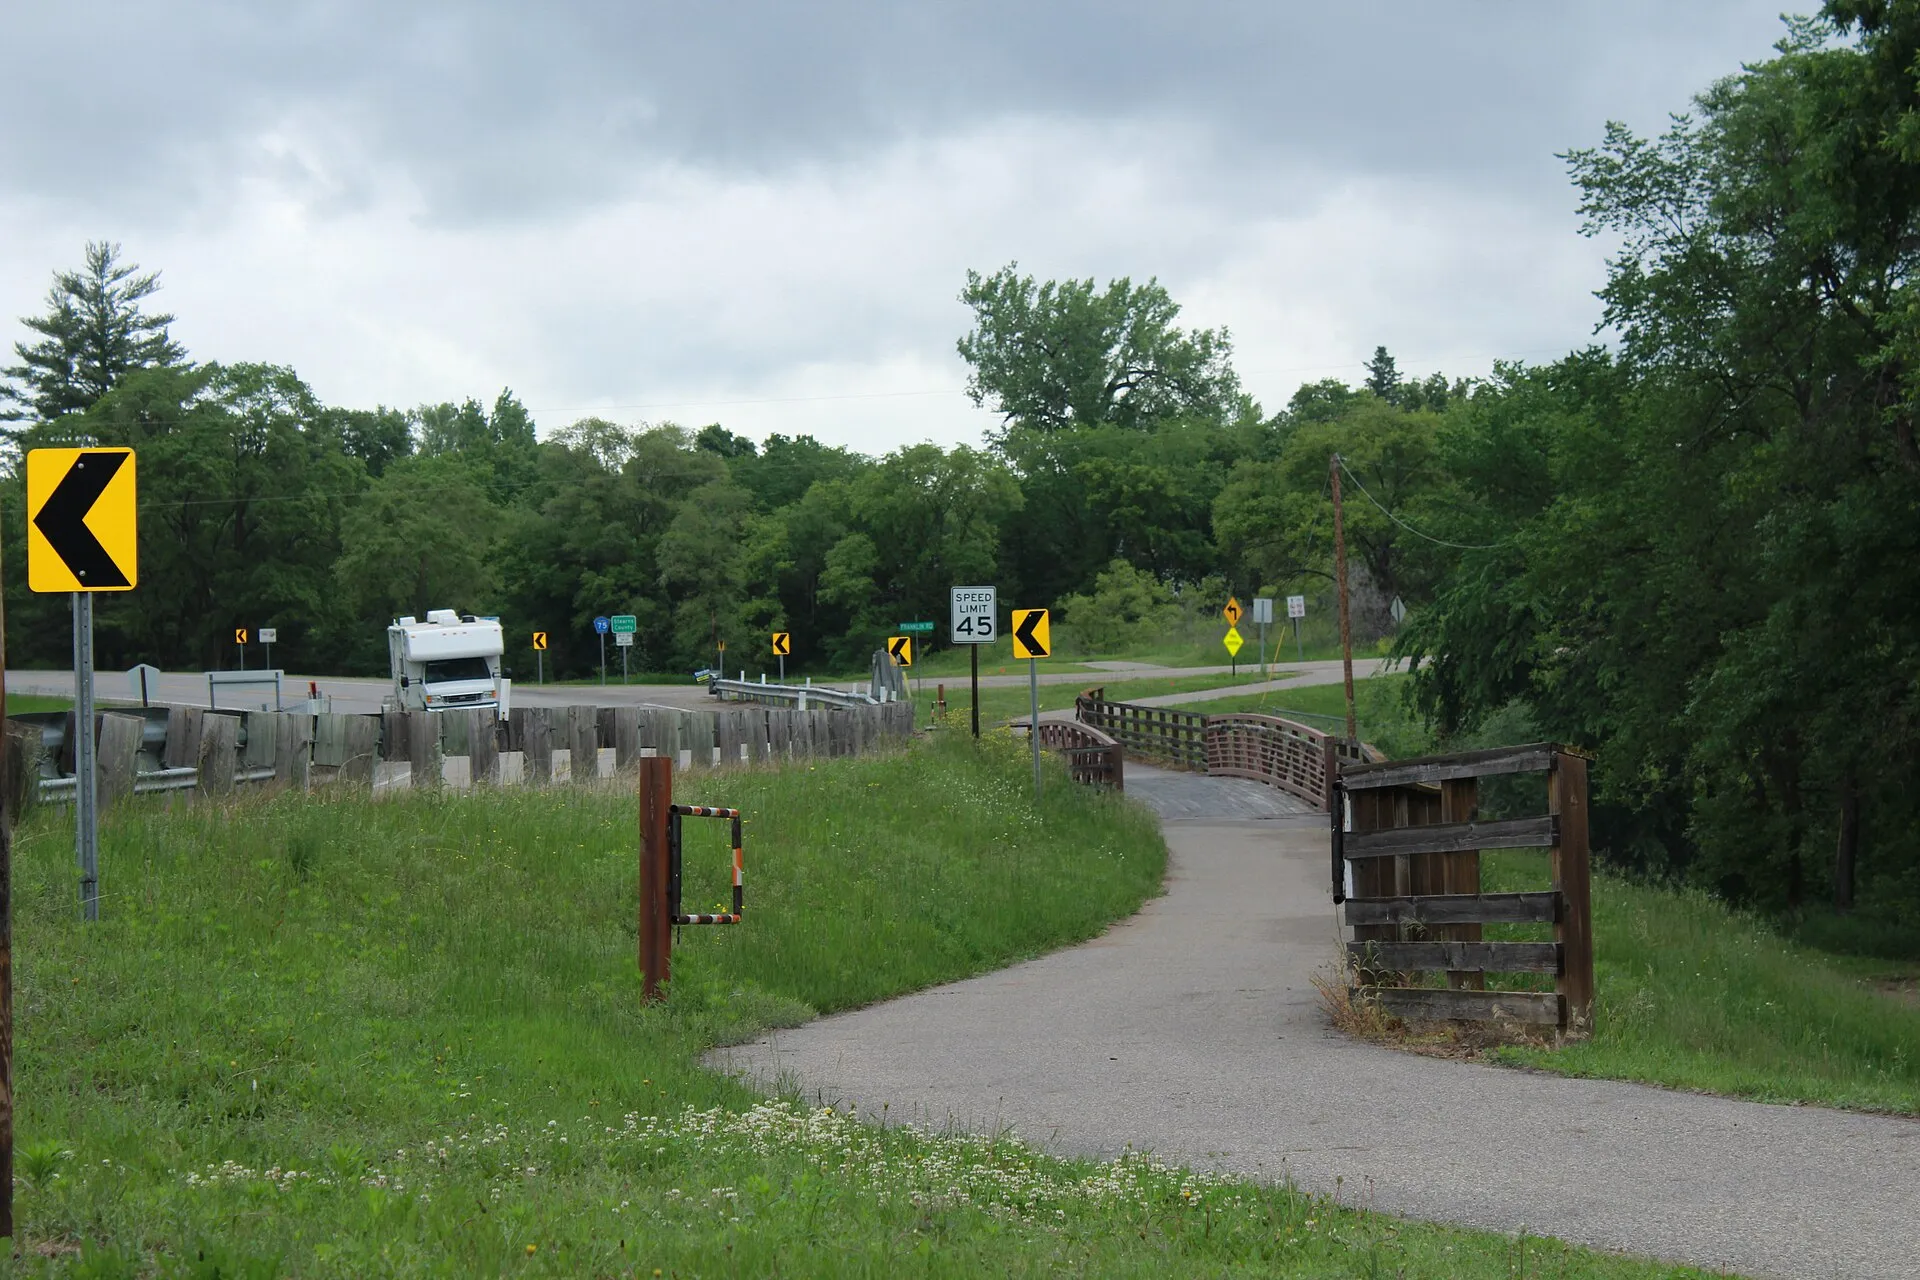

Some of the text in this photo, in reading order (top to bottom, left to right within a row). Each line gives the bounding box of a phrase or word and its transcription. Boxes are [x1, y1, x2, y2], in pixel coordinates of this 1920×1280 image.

[956, 594, 992, 602] SPEED
[960, 605, 987, 613] LIMIT
[900, 622, 924, 630] FRANKLIN
[956, 617, 992, 636] 45
